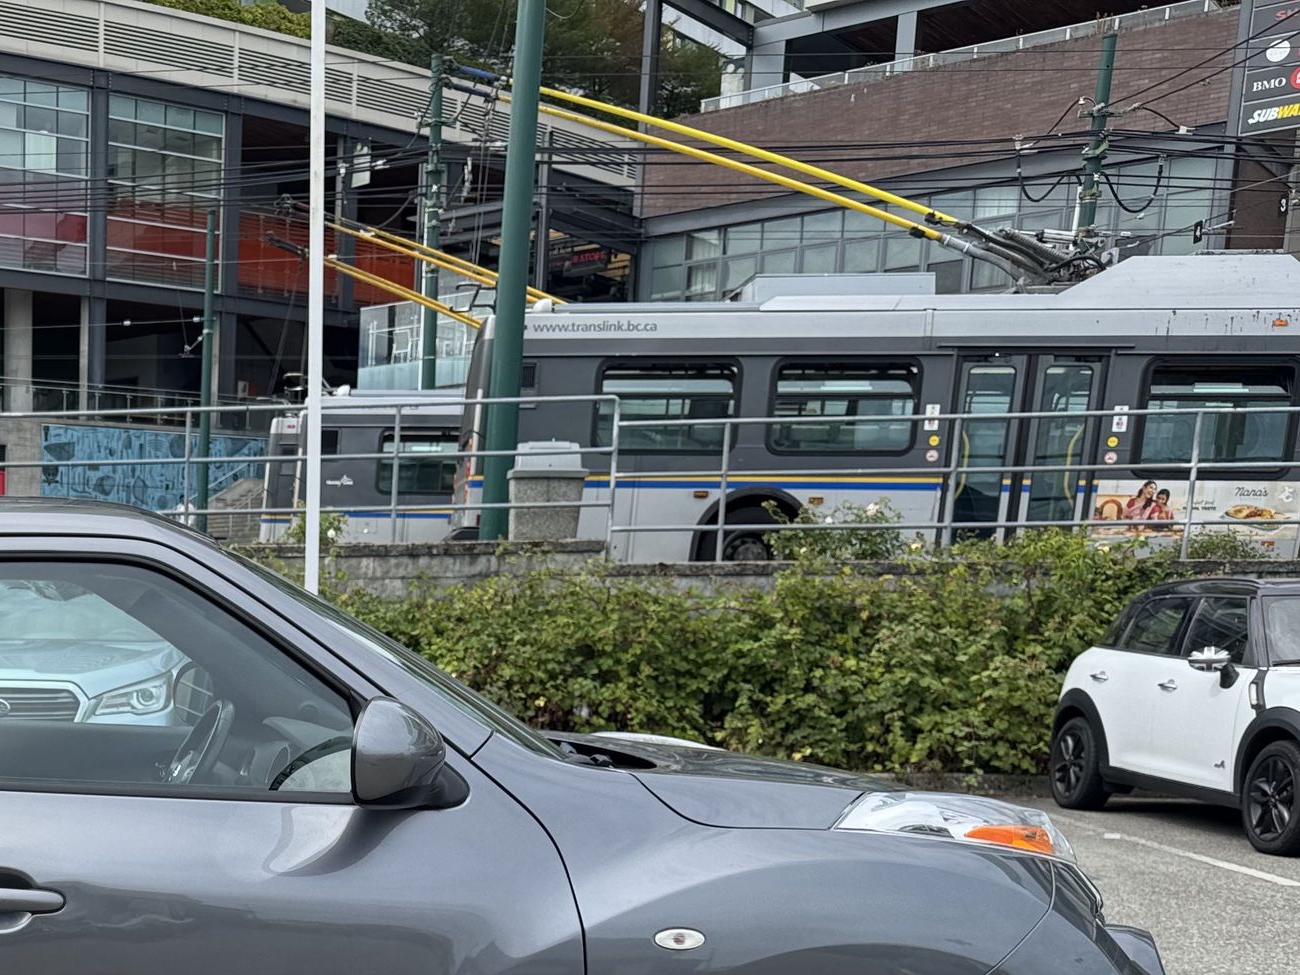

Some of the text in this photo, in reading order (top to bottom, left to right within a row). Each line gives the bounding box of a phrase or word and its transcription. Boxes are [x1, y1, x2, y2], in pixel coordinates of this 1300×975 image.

[1252, 77, 1286, 92] BMO
[1247, 103, 1300, 125] SUBWA
[533, 320, 658, 333] www.translink.bc.ca
